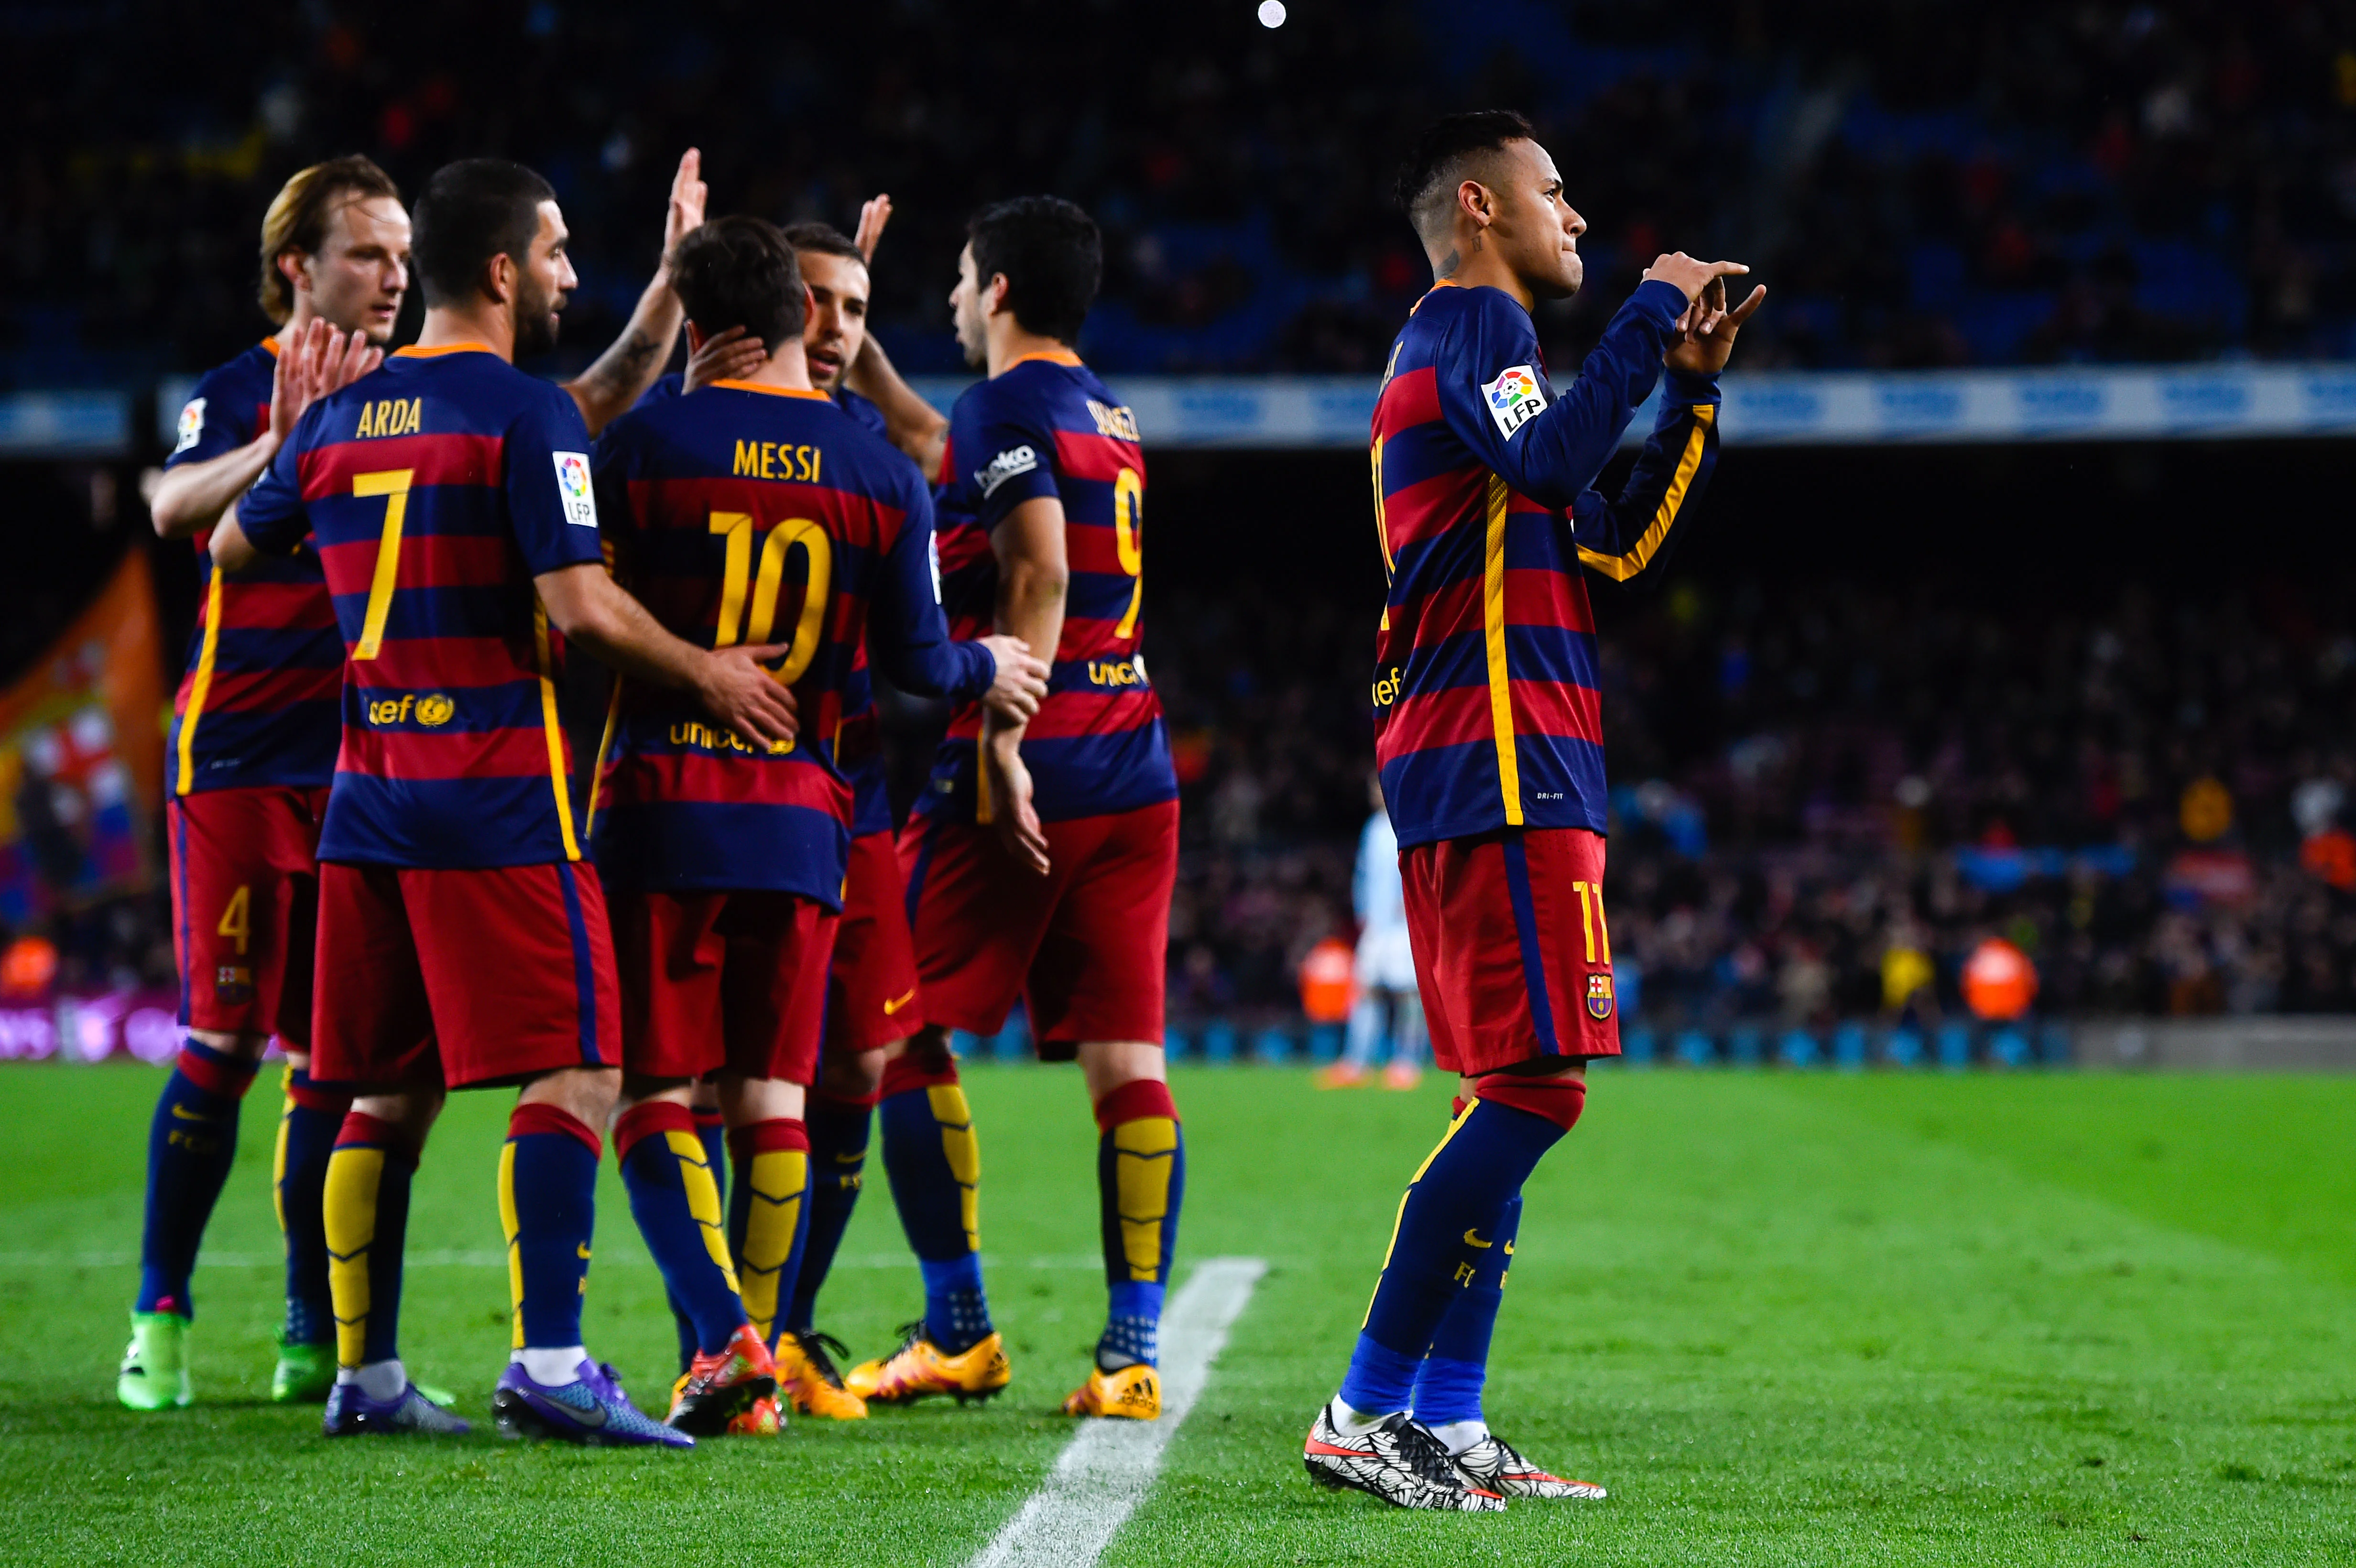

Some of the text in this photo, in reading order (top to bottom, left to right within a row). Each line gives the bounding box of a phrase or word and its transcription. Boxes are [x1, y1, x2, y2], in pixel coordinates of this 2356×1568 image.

[355, 397, 422, 439] ARDA
[1503, 399, 1540, 433] LFP
[733, 439, 821, 483] MESSI
[567, 501, 590, 523] LFP
[352, 468, 414, 661] 7
[1114, 467, 1143, 639] 9
[709, 511, 832, 686] 10
[218, 883, 251, 956] 4
[1572, 881, 1610, 965] 11
